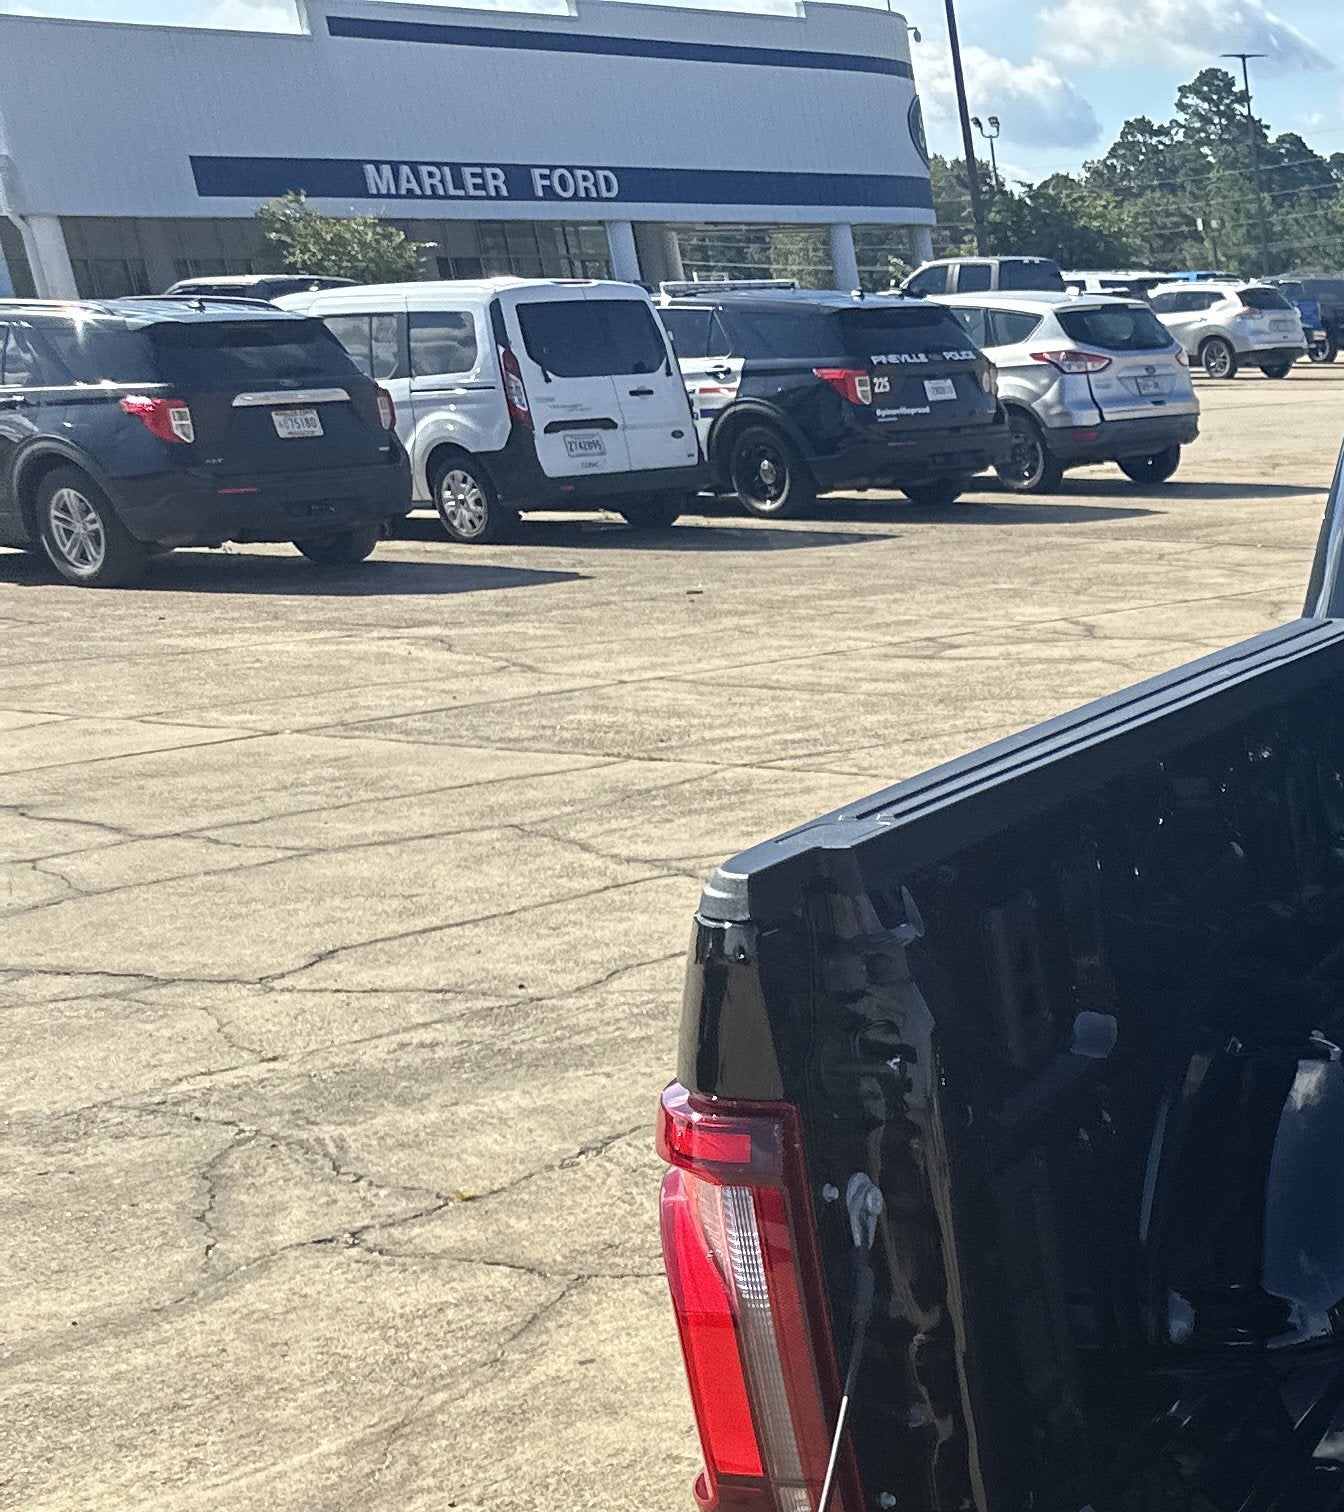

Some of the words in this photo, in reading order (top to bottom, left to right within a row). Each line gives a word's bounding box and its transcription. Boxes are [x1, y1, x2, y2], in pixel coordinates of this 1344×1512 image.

[363, 164, 508, 196] MARLER
[530, 168, 619, 198] FORD
[873, 377, 890, 393] 225
